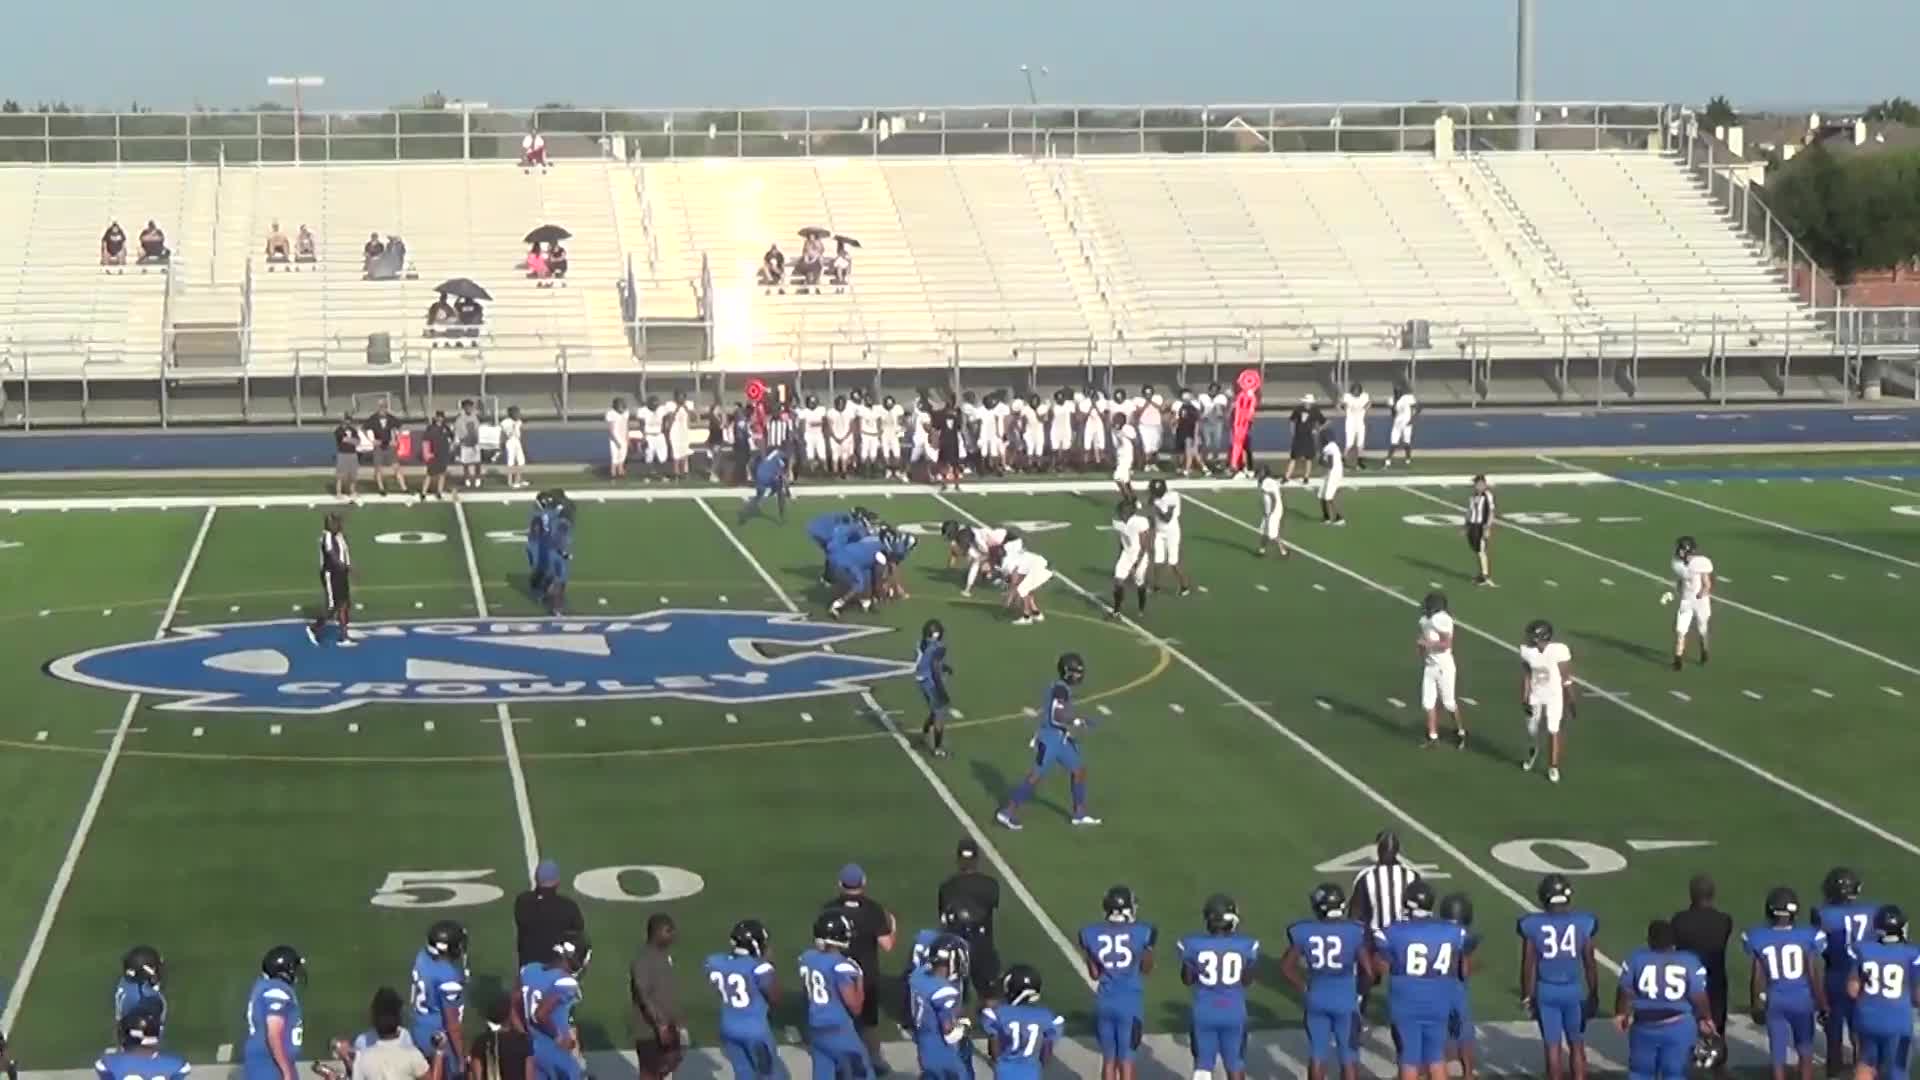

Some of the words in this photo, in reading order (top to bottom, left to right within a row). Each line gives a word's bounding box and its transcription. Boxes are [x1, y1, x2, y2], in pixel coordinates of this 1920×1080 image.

[277, 671, 769, 695] CROWLEY
[1541, 924, 1576, 958] 34
[1845, 914, 1868, 945] 17
[1098, 934, 1132, 968] 25
[1198, 951, 1242, 985] 30
[1308, 935, 1343, 969] 32
[1406, 942, 1452, 976] 64
[1762, 944, 1803, 980] 10
[1638, 964, 1686, 1000] 45
[1862, 961, 1904, 999] 39
